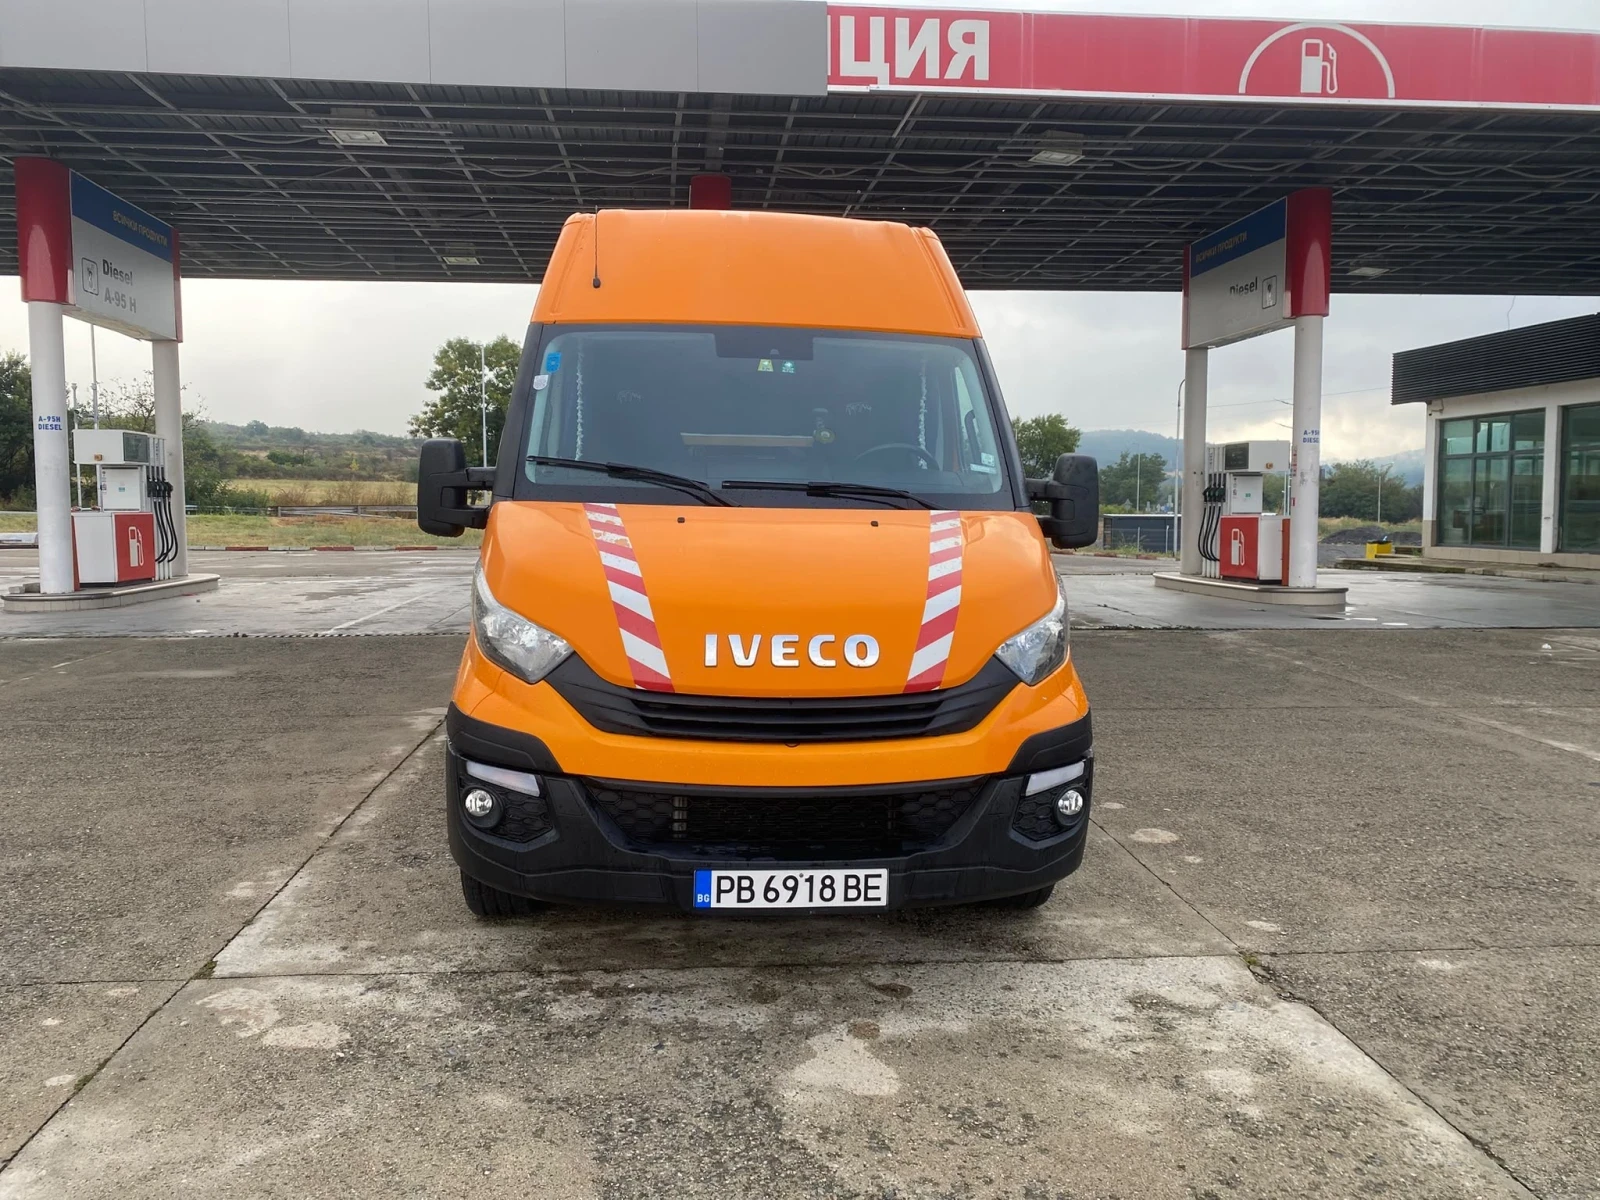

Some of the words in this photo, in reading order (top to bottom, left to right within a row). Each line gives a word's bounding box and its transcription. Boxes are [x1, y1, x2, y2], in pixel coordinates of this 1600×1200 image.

[827, 15, 989, 86] ЦИЯ
[102, 258, 133, 286] Diesel
[704, 634, 880, 667] IVECO
[697, 893, 710, 903] BG
[716, 875, 755, 904] PB
[763, 874, 836, 903] 6918
[843, 873, 882, 902] BE
